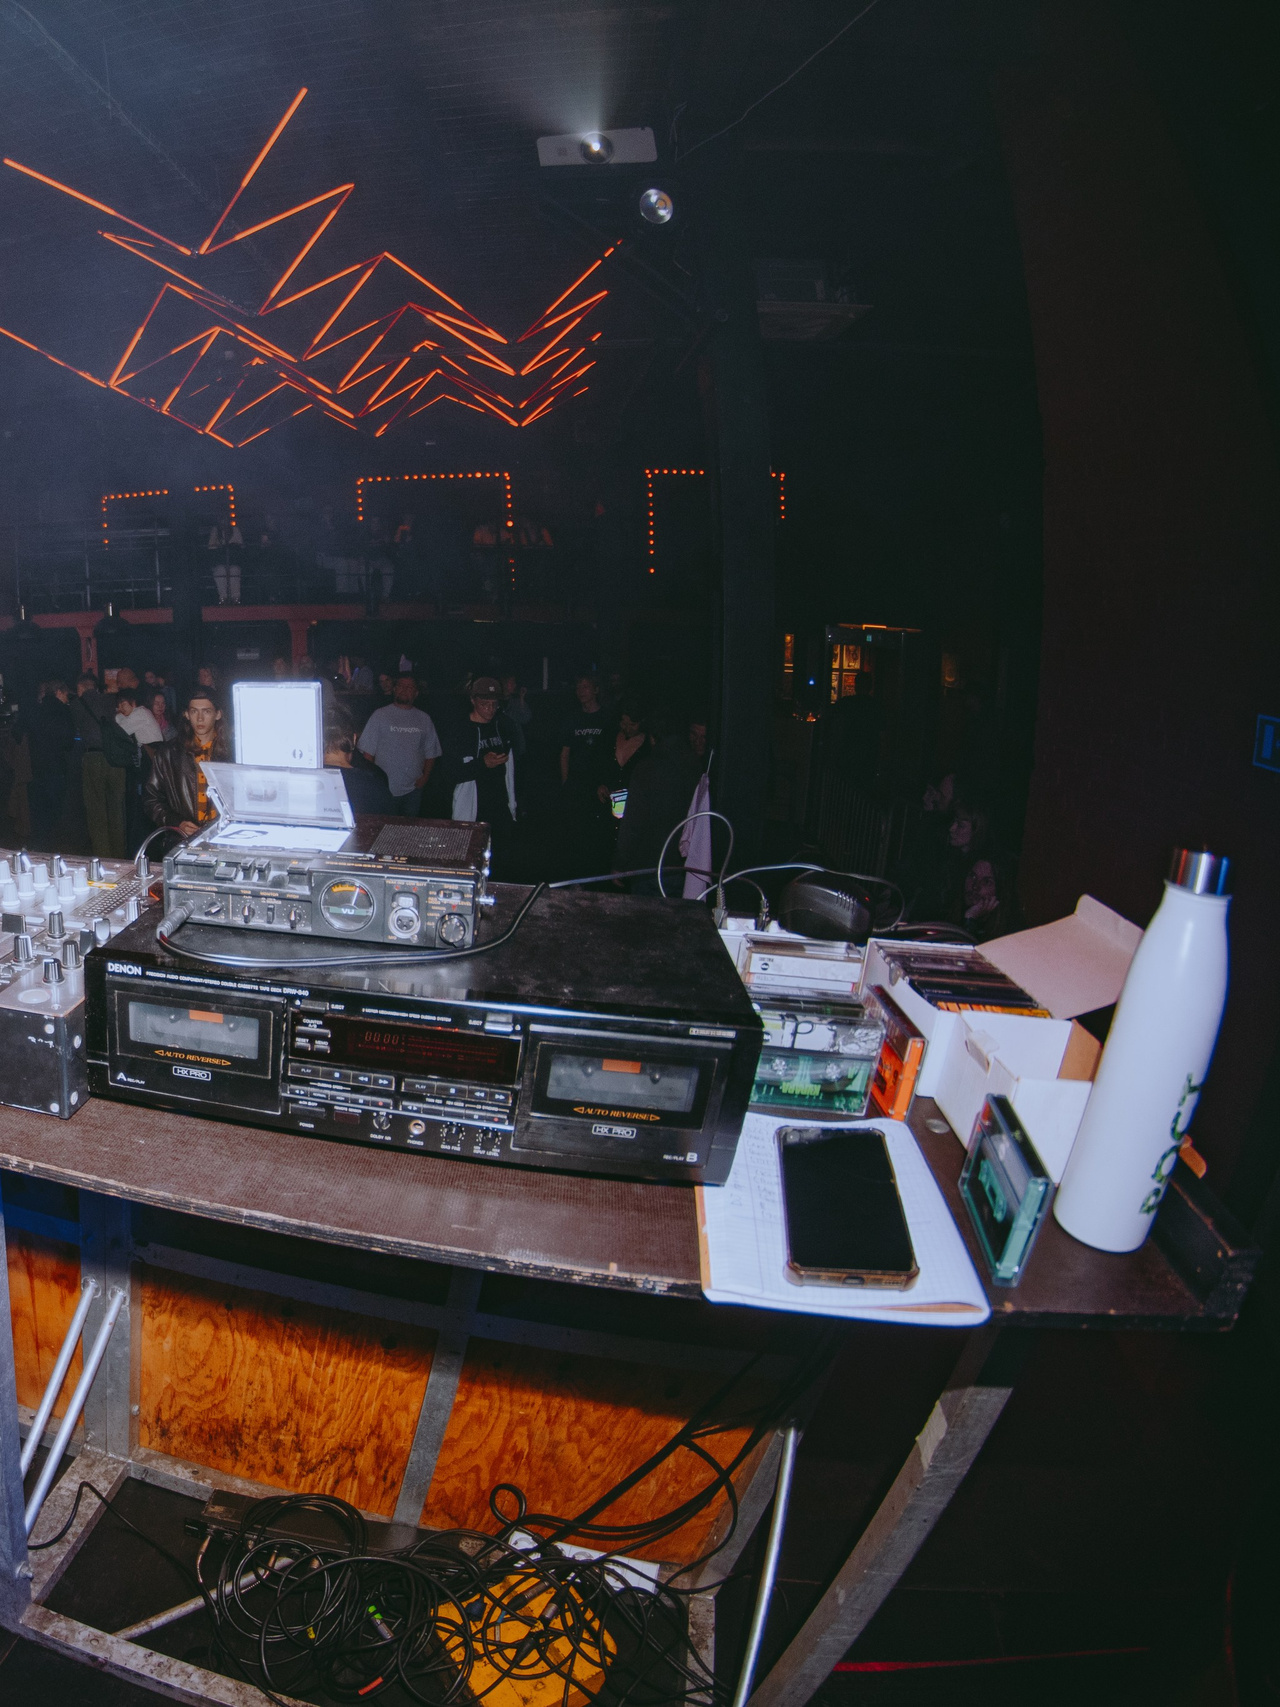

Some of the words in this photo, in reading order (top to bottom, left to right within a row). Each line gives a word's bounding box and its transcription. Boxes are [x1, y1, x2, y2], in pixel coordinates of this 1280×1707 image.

[107, 962, 142, 976] DENON
[163, 1051, 185, 1060] AUTO
[186, 1054, 222, 1065] REVERSE
[116, 1072, 127, 1082] A
[176, 1068, 189, 1076] HX
[189, 1070, 208, 1079] PRO
[584, 1107, 609, 1116] AUTO
[609, 1110, 651, 1121] REVERSE
[595, 1126, 609, 1135] HX
[611, 1128, 632, 1137] PRO
[686, 1151, 698, 1162] B
